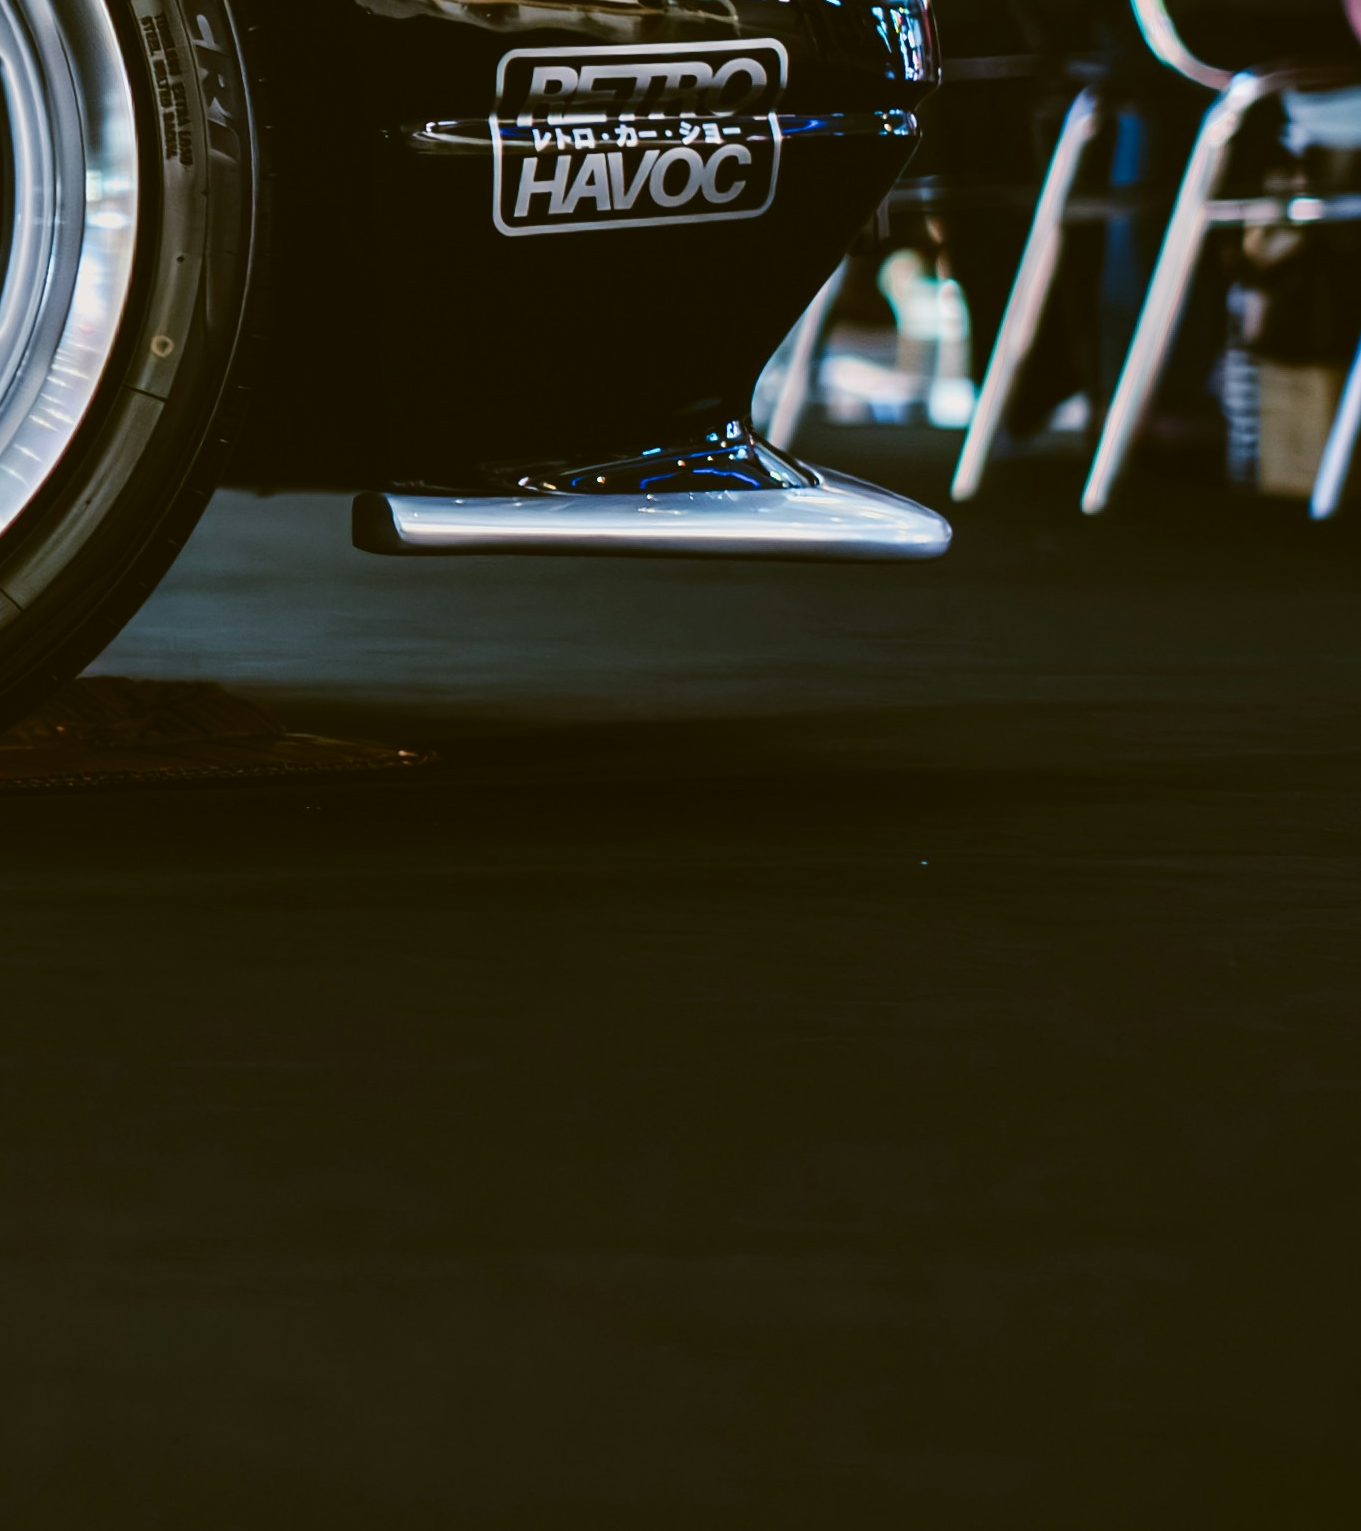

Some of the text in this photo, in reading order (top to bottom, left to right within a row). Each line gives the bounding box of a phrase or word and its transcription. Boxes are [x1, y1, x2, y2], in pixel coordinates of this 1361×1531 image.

[516, 58, 767, 127] RETRO
[532, 122, 741, 153] レトロ・カー・ショー
[514, 144, 752, 218] HAVOC
